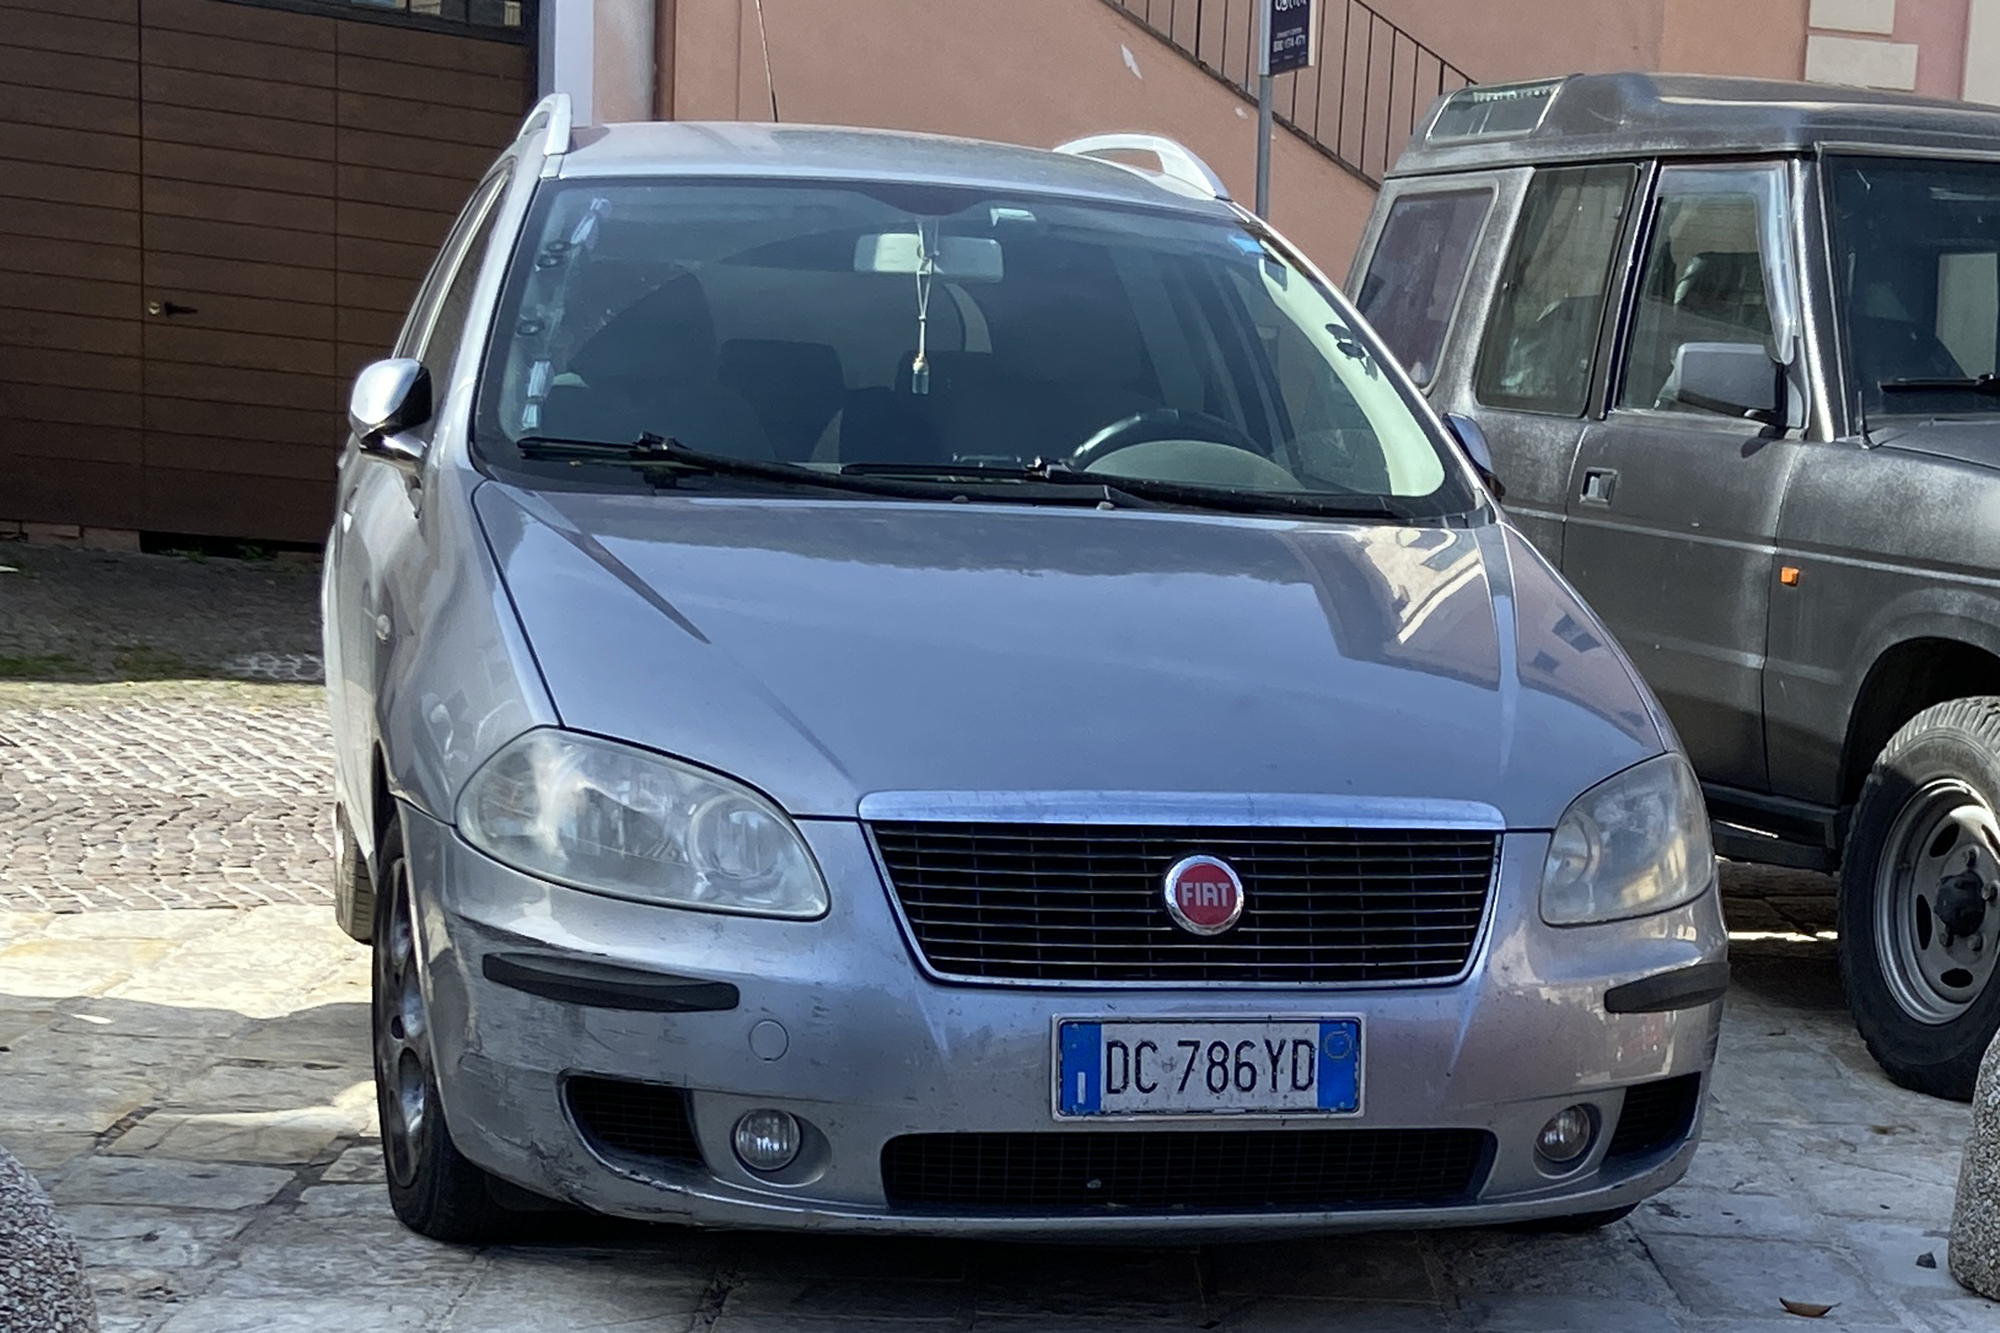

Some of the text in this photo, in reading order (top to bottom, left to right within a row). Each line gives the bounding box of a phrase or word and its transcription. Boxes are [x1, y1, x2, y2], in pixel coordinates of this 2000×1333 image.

[1181, 882, 1230, 907] FIAT
[1105, 1040, 1316, 1094] DC 786YD
[1077, 1071, 1086, 1104] I
